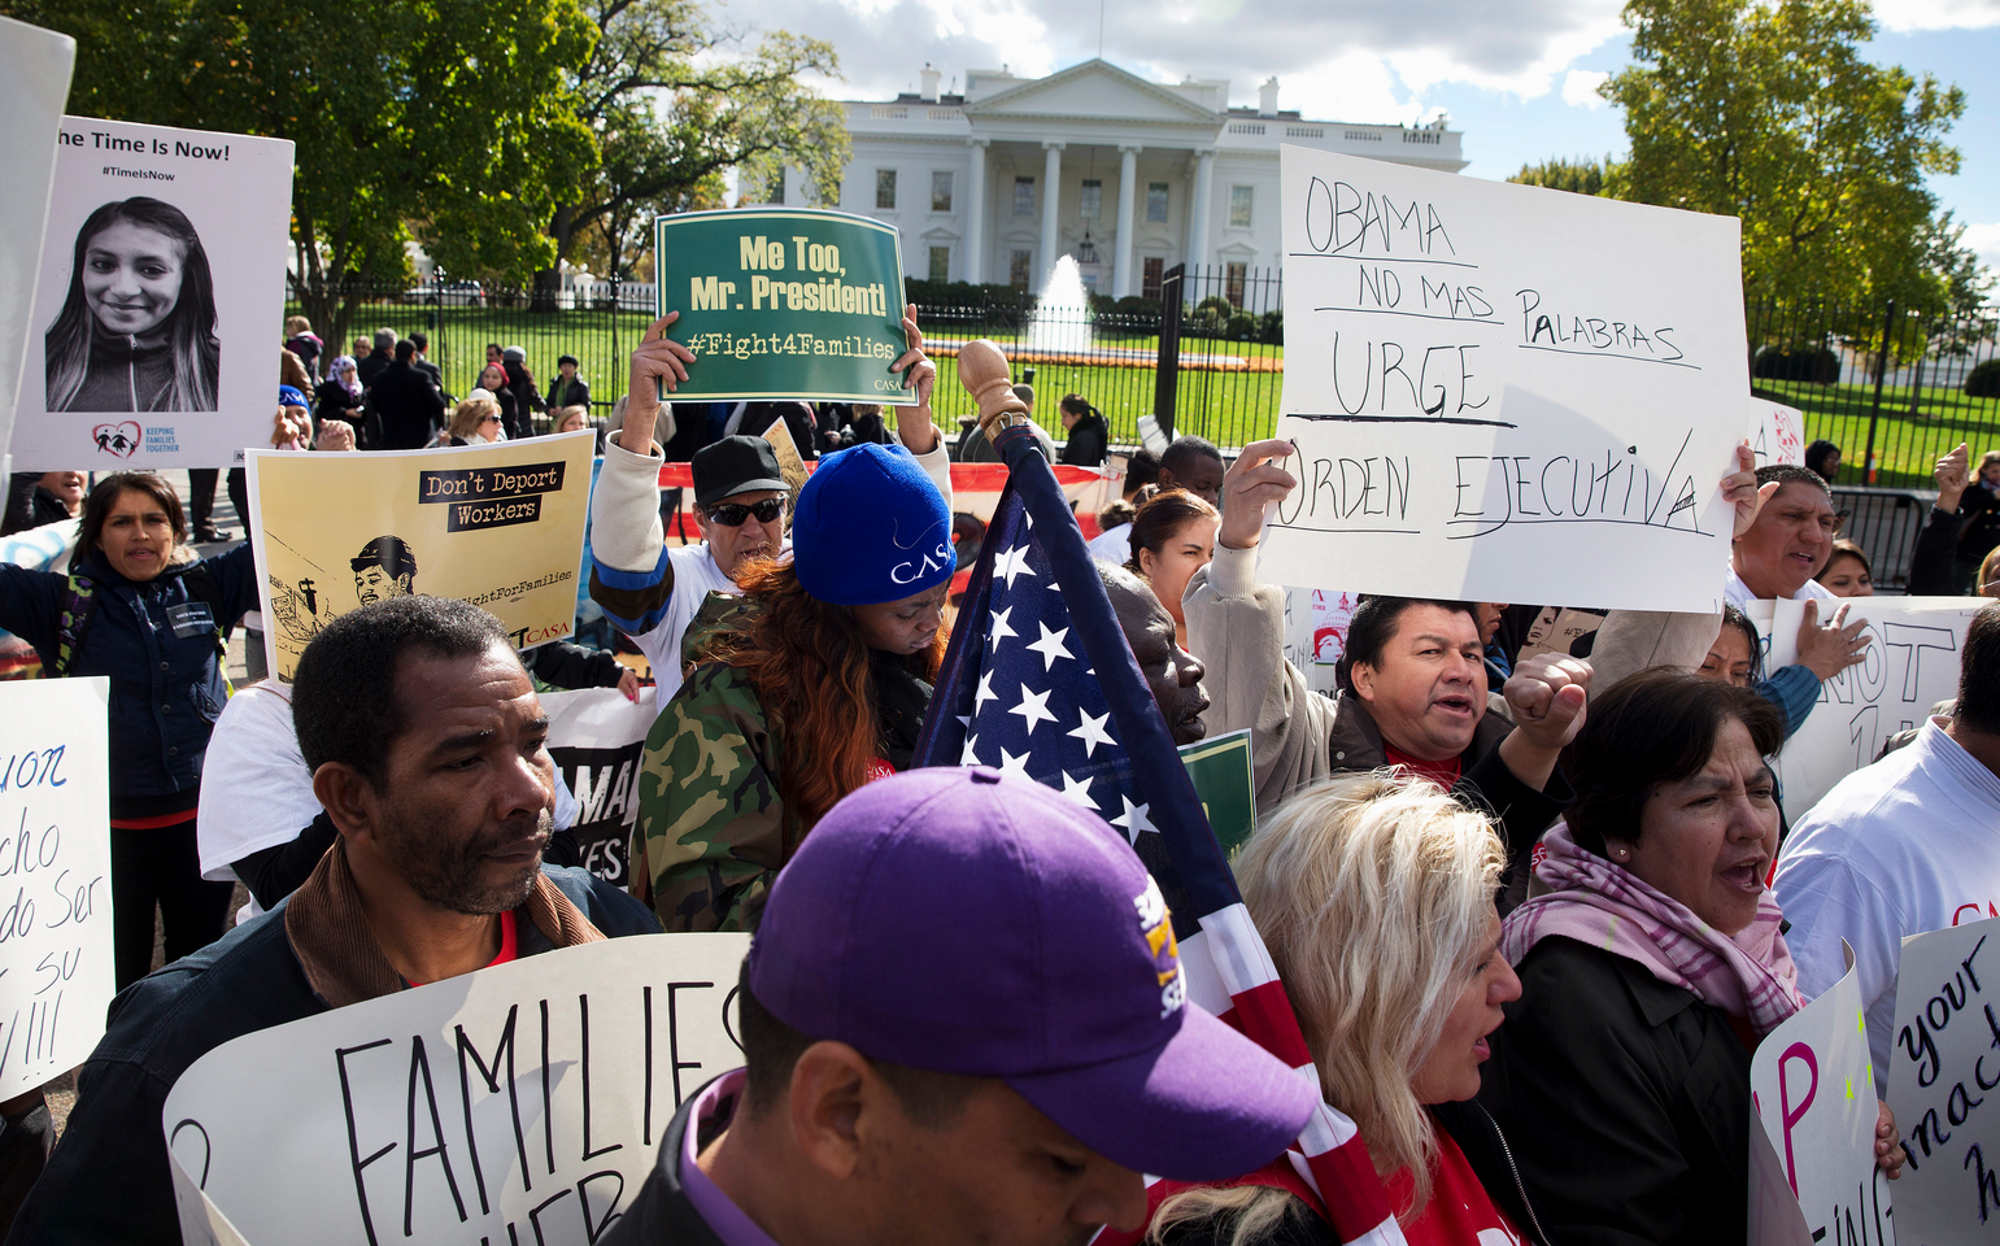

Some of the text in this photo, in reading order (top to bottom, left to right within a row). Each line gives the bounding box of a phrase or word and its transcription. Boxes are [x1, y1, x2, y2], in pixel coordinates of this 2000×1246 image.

[58, 128, 230, 161] he Time Is Now!
[102, 166, 176, 182] #TimeIsNow
[1306, 176, 1456, 256] OBAMA
[739, 235, 847, 277] Me Too,
[690, 275, 887, 317] Mr. President!
[1359, 264, 1684, 361] NO MAS PALABRAS
[687, 333, 895, 360] #Fight4Families
[874, 379, 903, 392] CASA
[1333, 331, 1490, 418] URGE
[146, 427, 175, 435] KEEPING
[146, 444, 179, 452] TOGETHER
[426, 467, 558, 497] Don't Deport
[1278, 438, 1409, 525] ORDEN
[457, 501, 536, 525] Workers
[463, 570, 572, 607] ightForFamilies
[526, 622, 570, 643] CASA
[1898, 934, 1987, 1088] your
